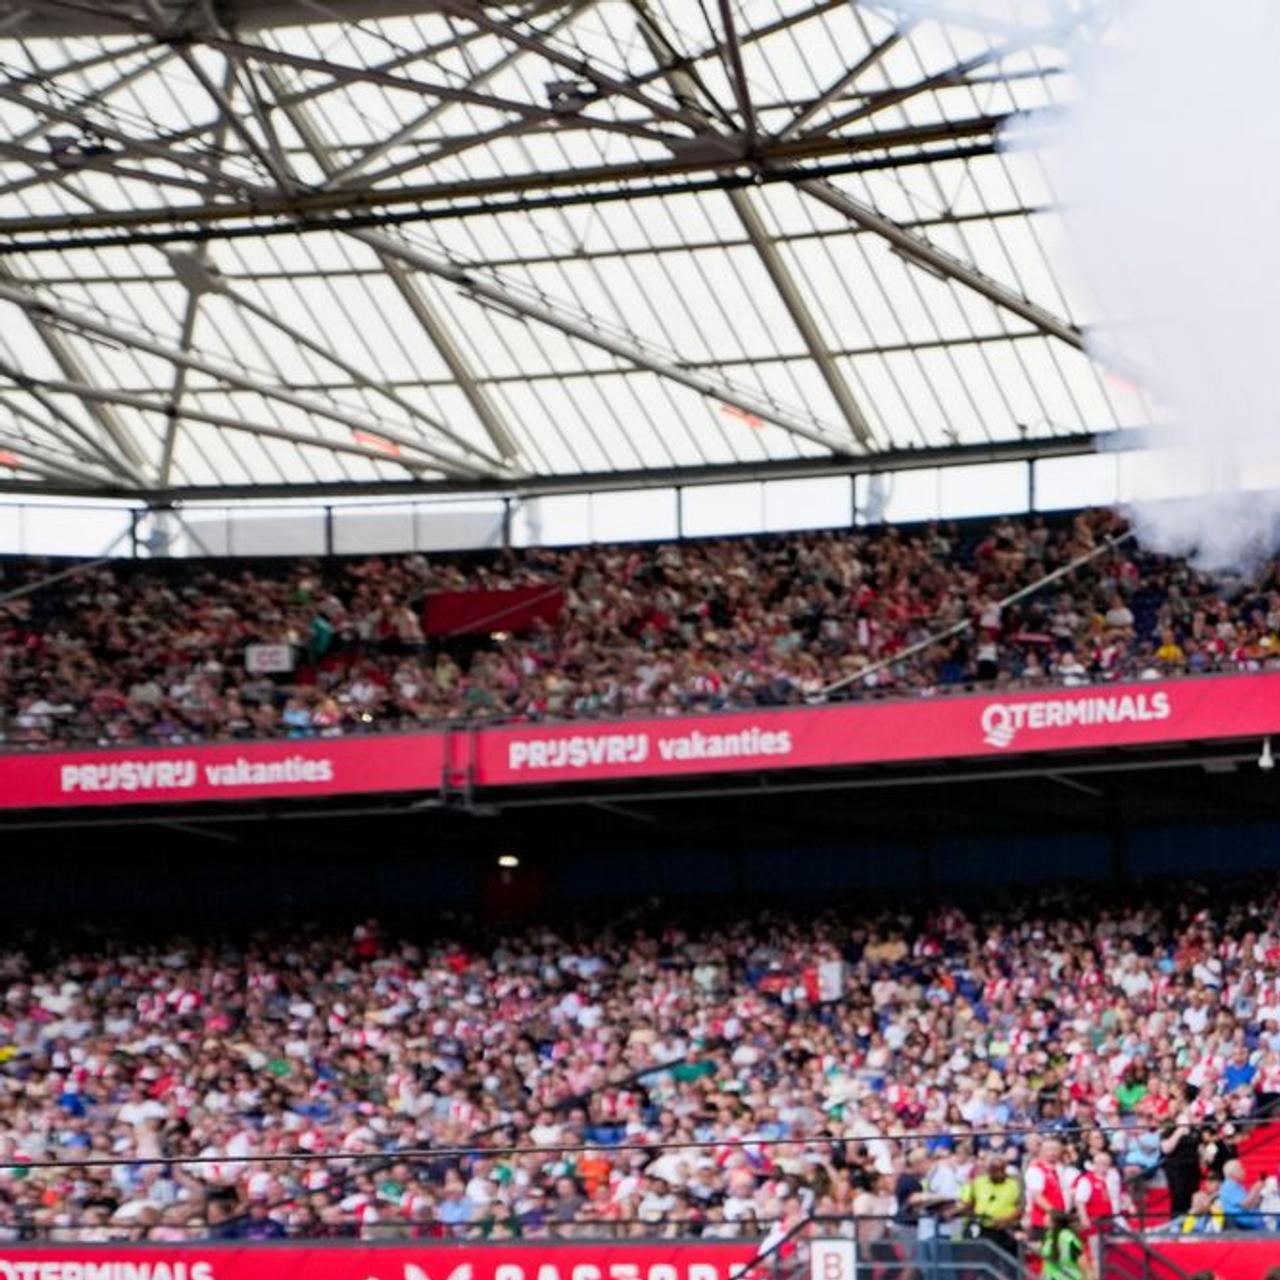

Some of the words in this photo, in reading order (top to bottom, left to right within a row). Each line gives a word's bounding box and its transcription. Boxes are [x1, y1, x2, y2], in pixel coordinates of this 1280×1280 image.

[981, 691, 1171, 748] QTERMINALS
[658, 726, 792, 760] vakanties
[205, 756, 333, 786] vakanties
